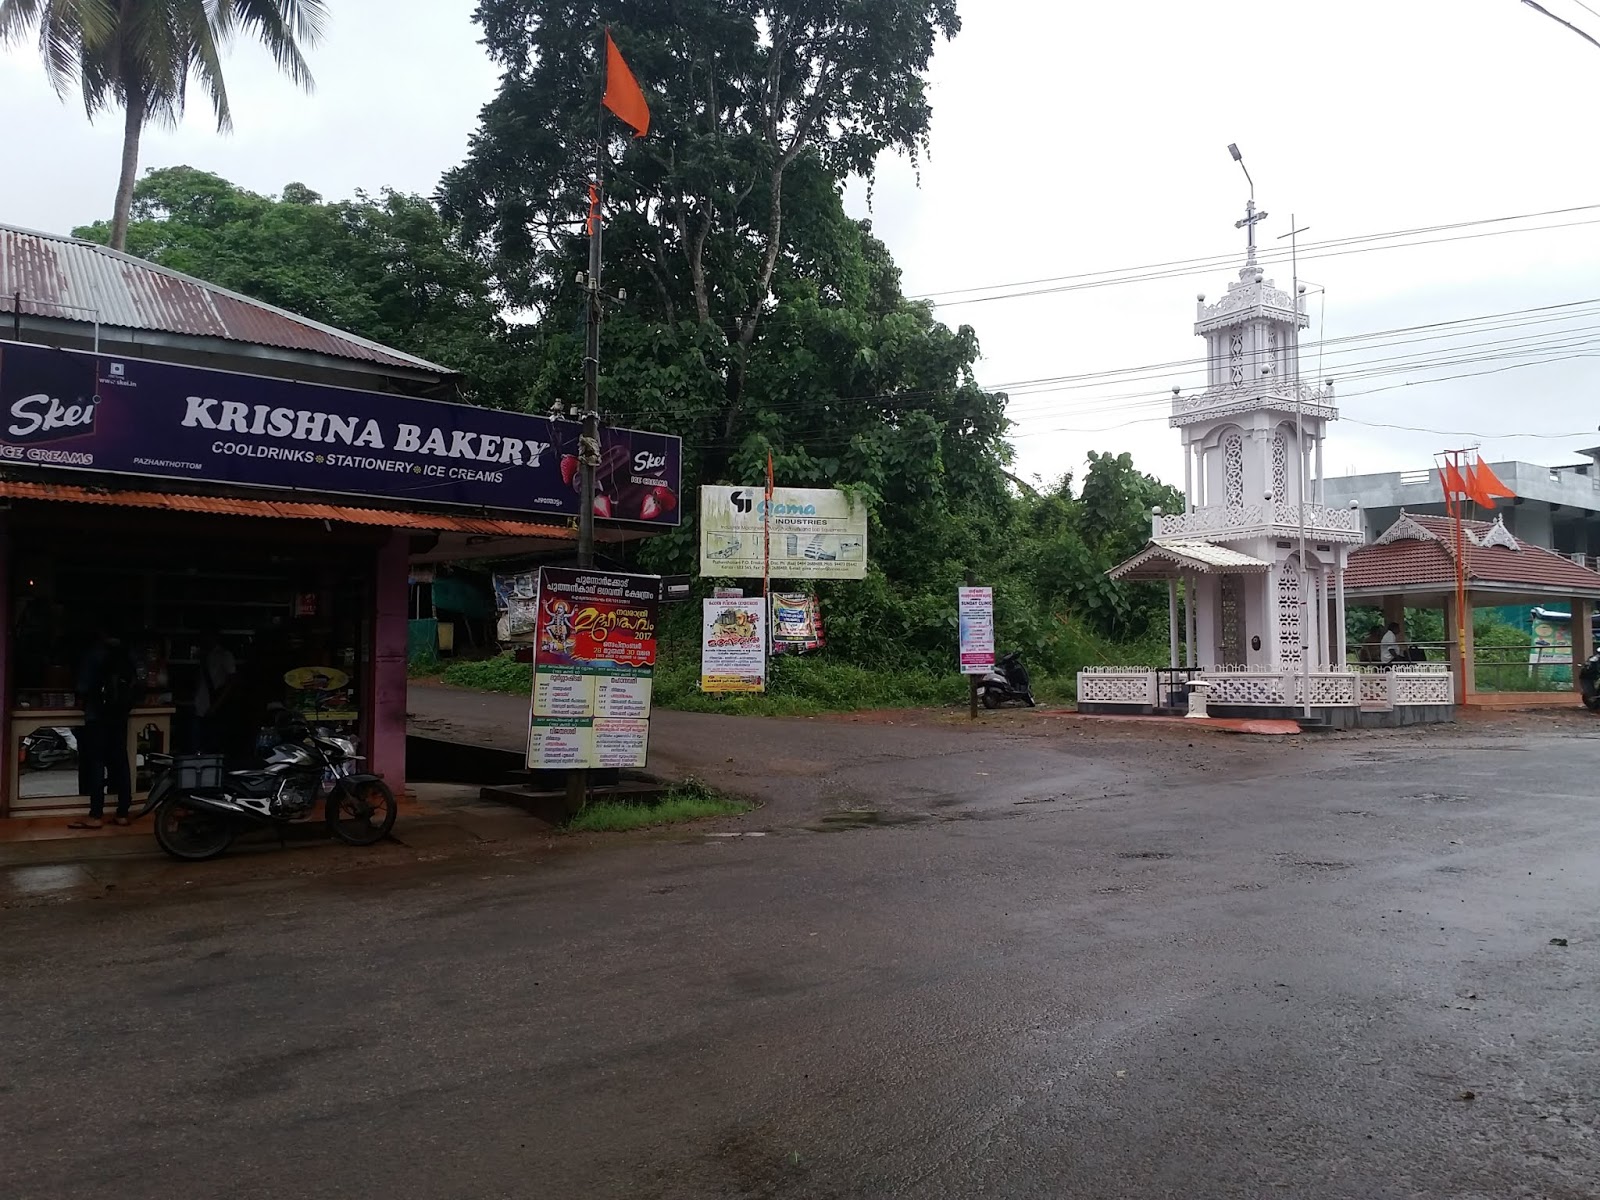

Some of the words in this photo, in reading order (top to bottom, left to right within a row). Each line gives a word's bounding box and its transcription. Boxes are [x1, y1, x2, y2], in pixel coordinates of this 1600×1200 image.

[9, 393, 95, 436] Skei
[181, 395, 386, 449] KRISHNA
[393, 423, 550, 468] BAKERY
[27, 448, 94, 466] CREAMS
[133, 457, 202, 470] PAZHANTHOTTOM
[212, 440, 314, 464] COOLDRINKS
[326, 452, 414, 475] STATIONERY
[423, 464, 447, 478] ICE
[449, 467, 504, 484] CREAMS
[630, 476, 642, 484] ICE
[757, 500, 816, 523] gama
[775, 518, 828, 526] INDUSTRIES
[634, 631, 653, 640] 2017
